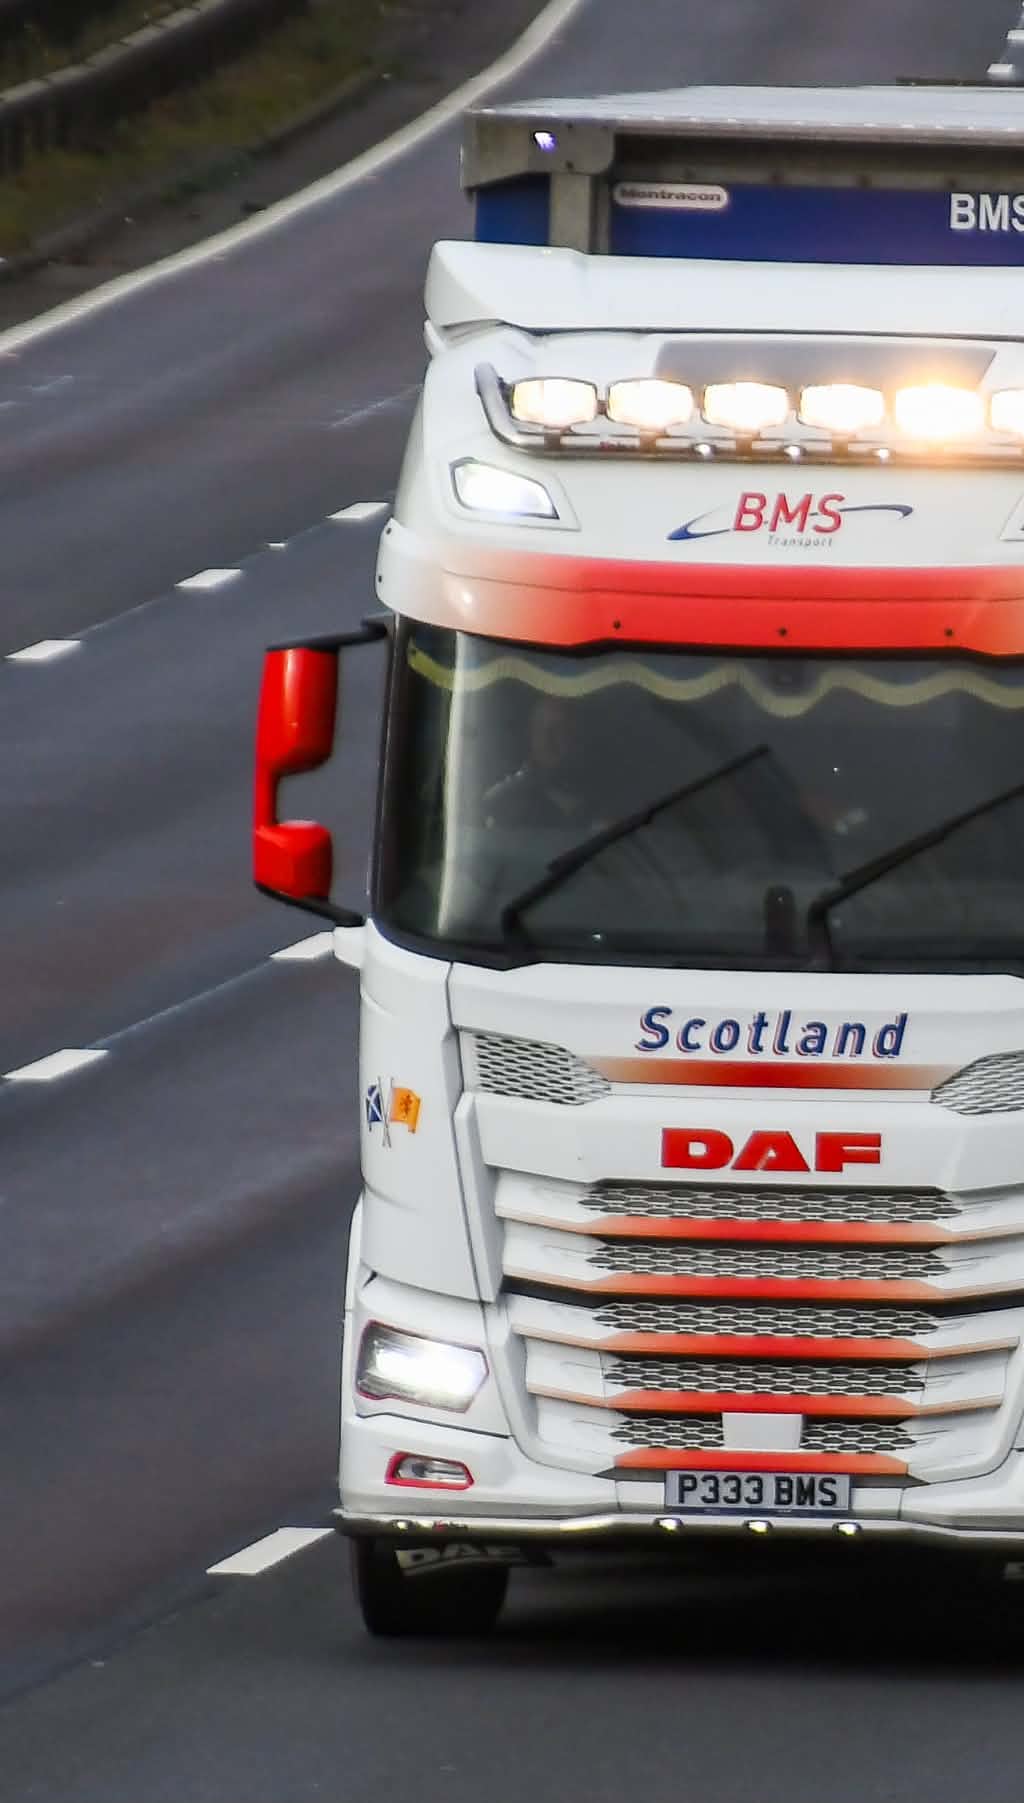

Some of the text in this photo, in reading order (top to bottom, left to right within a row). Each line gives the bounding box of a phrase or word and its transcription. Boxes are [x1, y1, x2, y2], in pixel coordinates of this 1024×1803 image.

[634, 1005, 909, 1058] Scotland
[661, 1127, 882, 1173] DAF
[678, 1474, 837, 1506] P333 BMS
